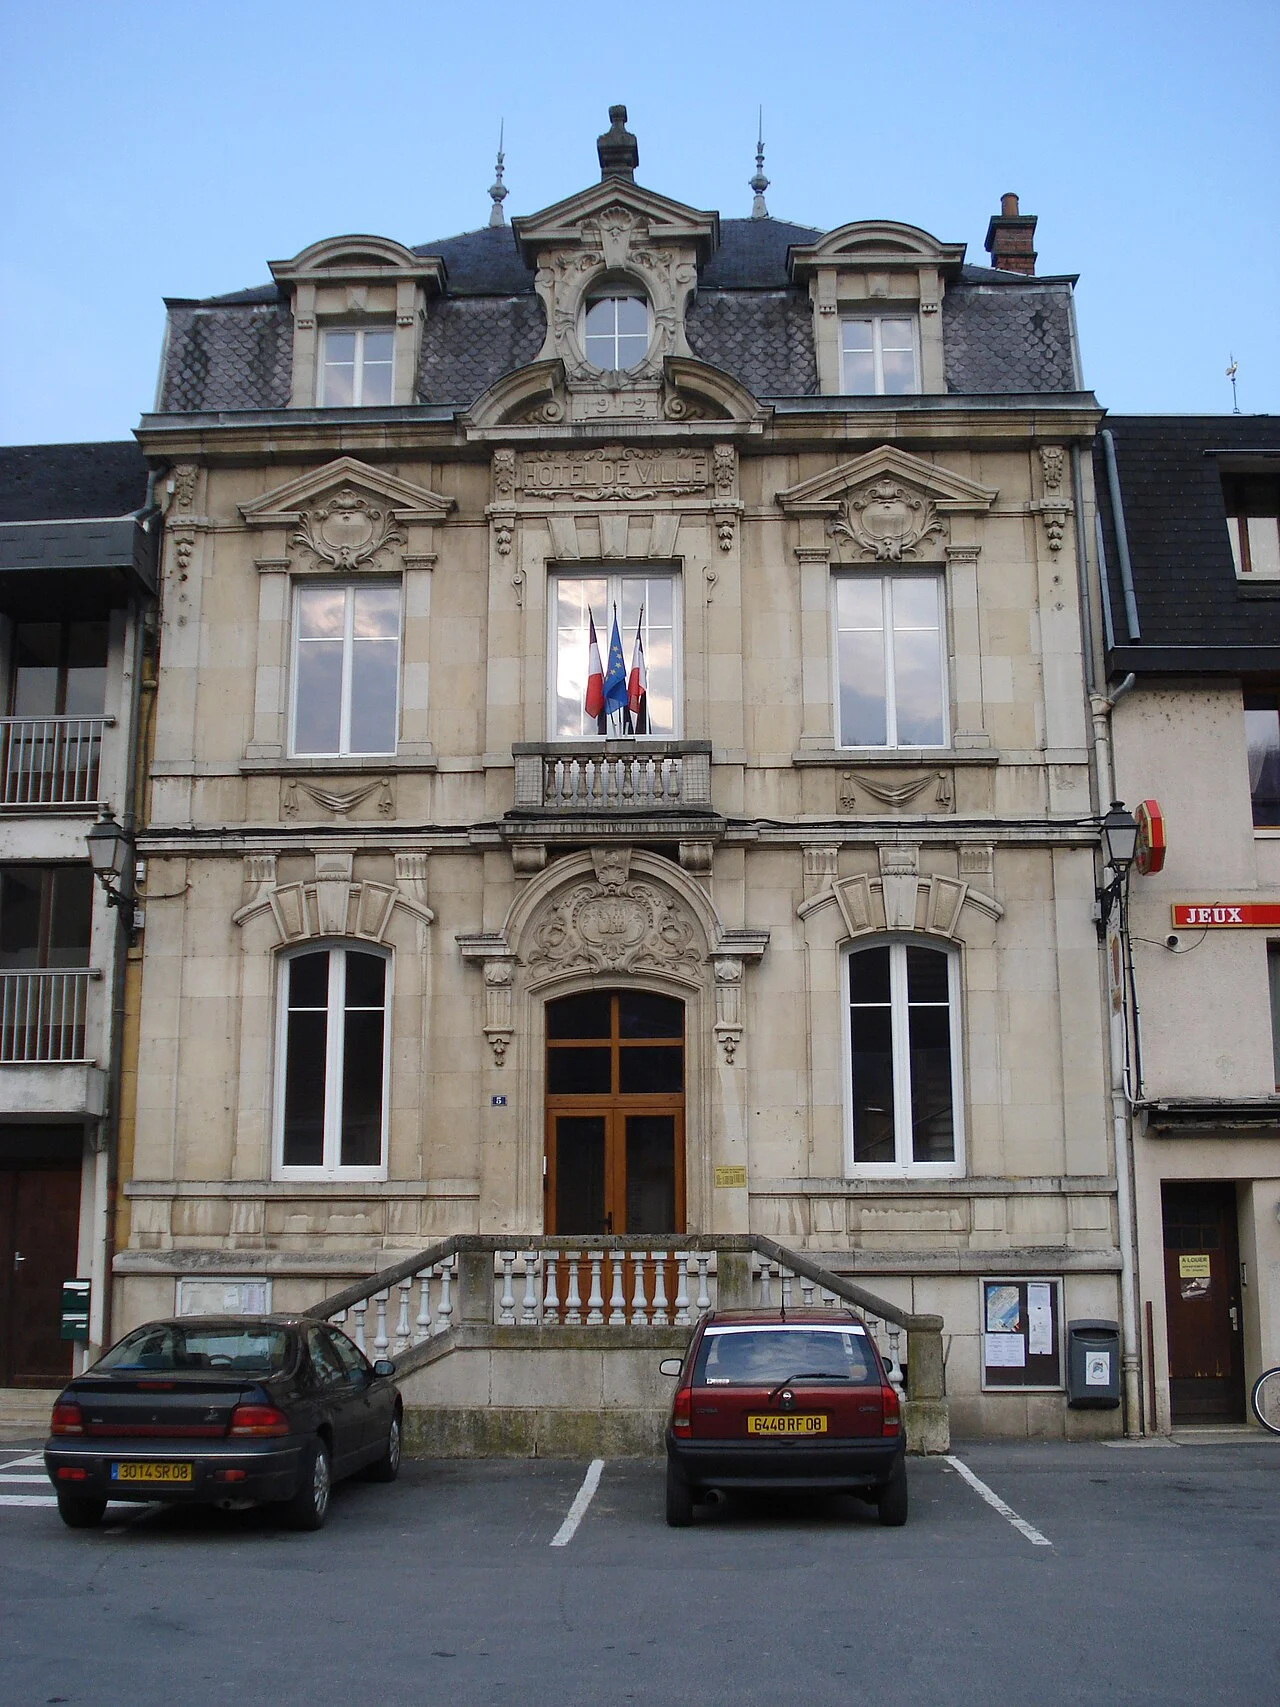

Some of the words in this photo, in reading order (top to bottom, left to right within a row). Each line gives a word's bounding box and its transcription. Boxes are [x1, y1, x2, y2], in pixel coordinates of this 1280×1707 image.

[583, 398, 646, 414] 1912
[524, 463, 597, 487] HOTEL
[601, 464, 630, 485] DE
[635, 460, 706, 485] VILLE
[1186, 907, 1243, 924] JEUX
[754, 1417, 786, 1431] 6448
[787, 1417, 804, 1431] RF
[805, 1417, 822, 1431] 08
[121, 1463, 153, 1479] 3014
[154, 1463, 171, 1479] SR
[172, 1463, 189, 1479] 08
